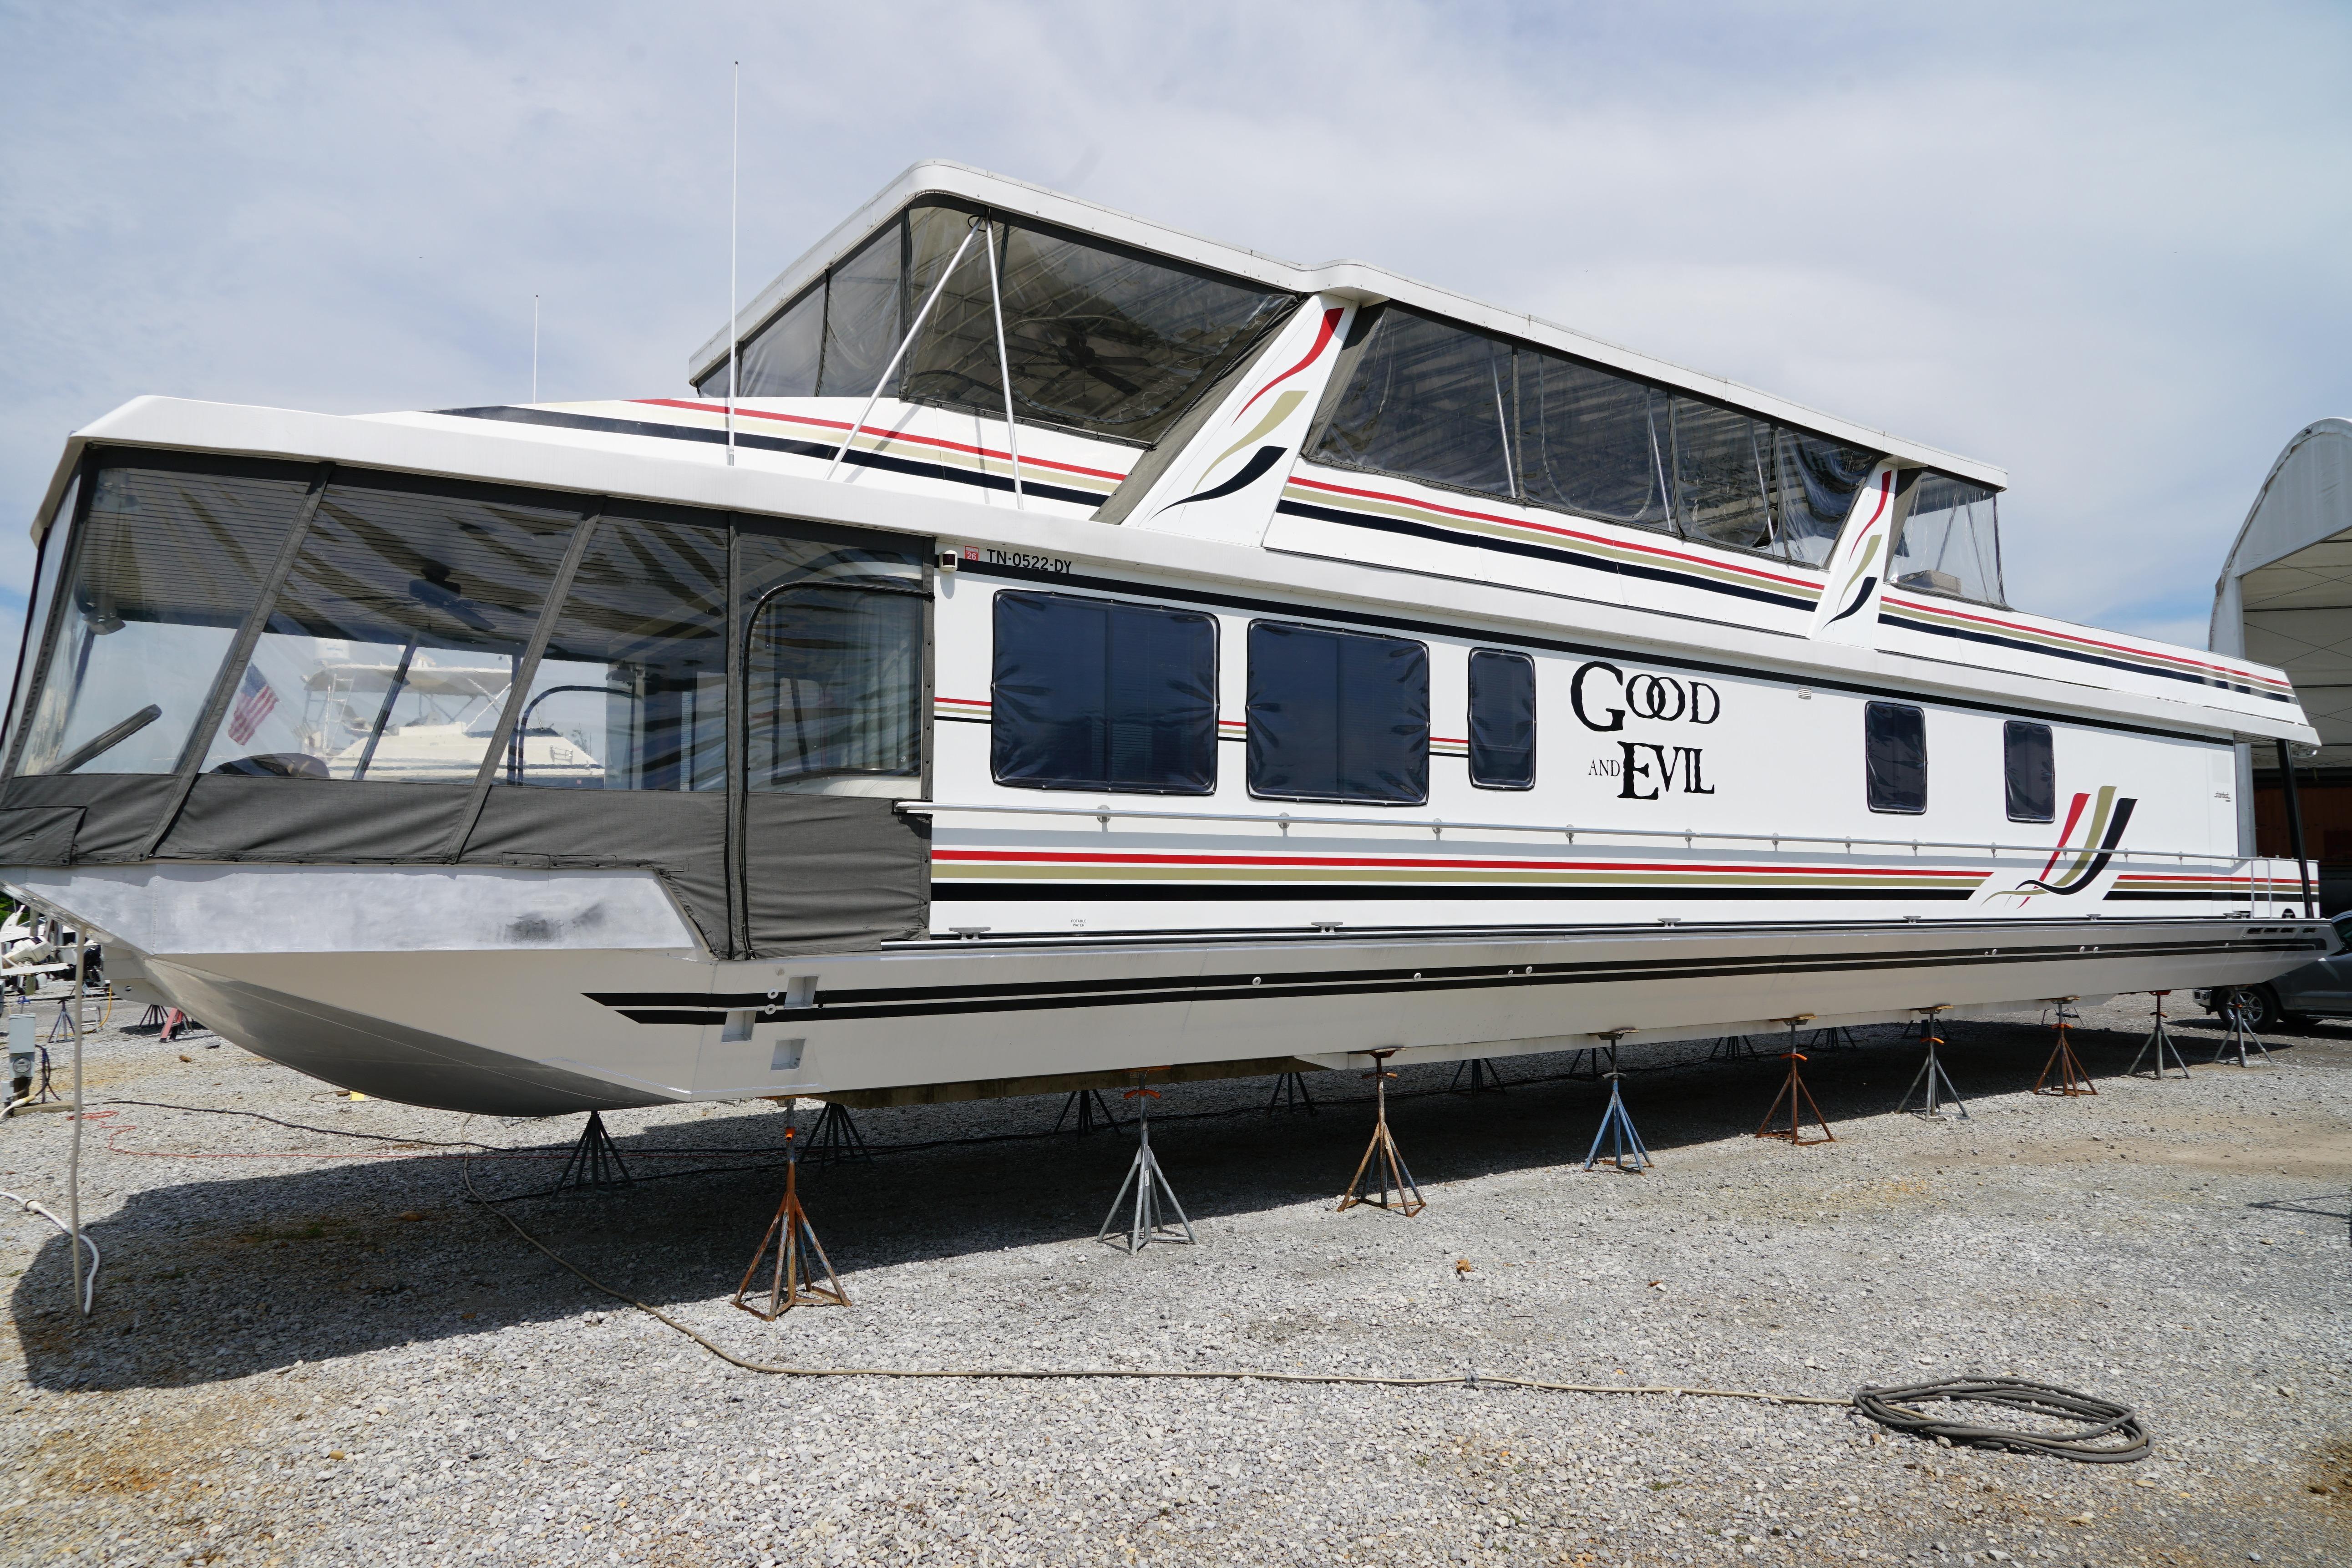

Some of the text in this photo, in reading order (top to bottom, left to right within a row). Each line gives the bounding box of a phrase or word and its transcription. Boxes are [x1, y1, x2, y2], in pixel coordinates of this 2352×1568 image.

[967, 552, 976, 560] 26
[987, 549, 1072, 574] TN-0522-DY
[1571, 661, 1720, 732] GOOD
[1588, 741, 1715, 800] AND EVIL
